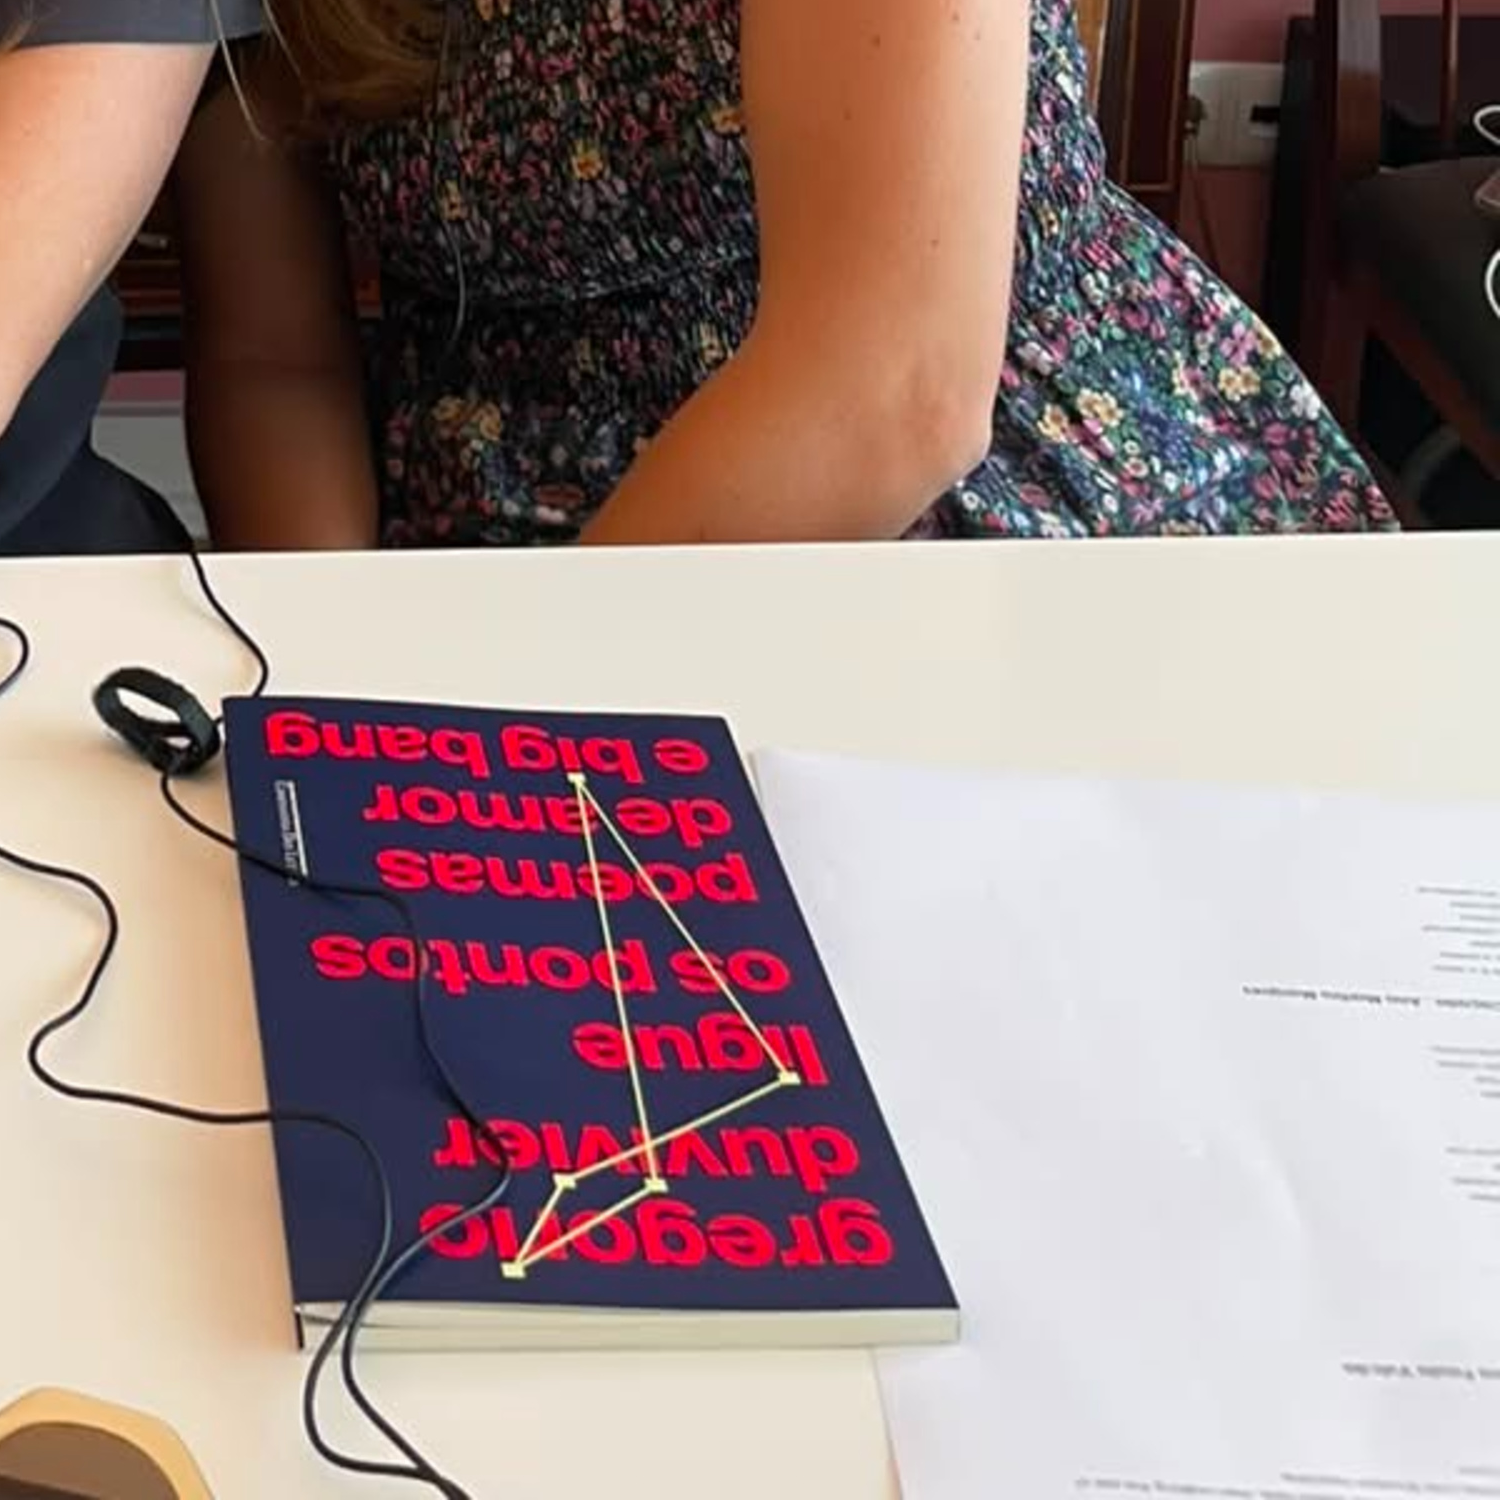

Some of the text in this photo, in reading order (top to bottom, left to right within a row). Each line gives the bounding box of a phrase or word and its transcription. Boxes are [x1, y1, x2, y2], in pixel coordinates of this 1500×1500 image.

[265, 711, 710, 785] e big bang
[363, 784, 734, 849] de amor
[376, 849, 759, 904] poemas
[310, 934, 792, 995] os pontos
[573, 1011, 829, 1086] ligue
[433, 1117, 860, 1194] duvivier
[419, 1197, 894, 1270] gregorio
